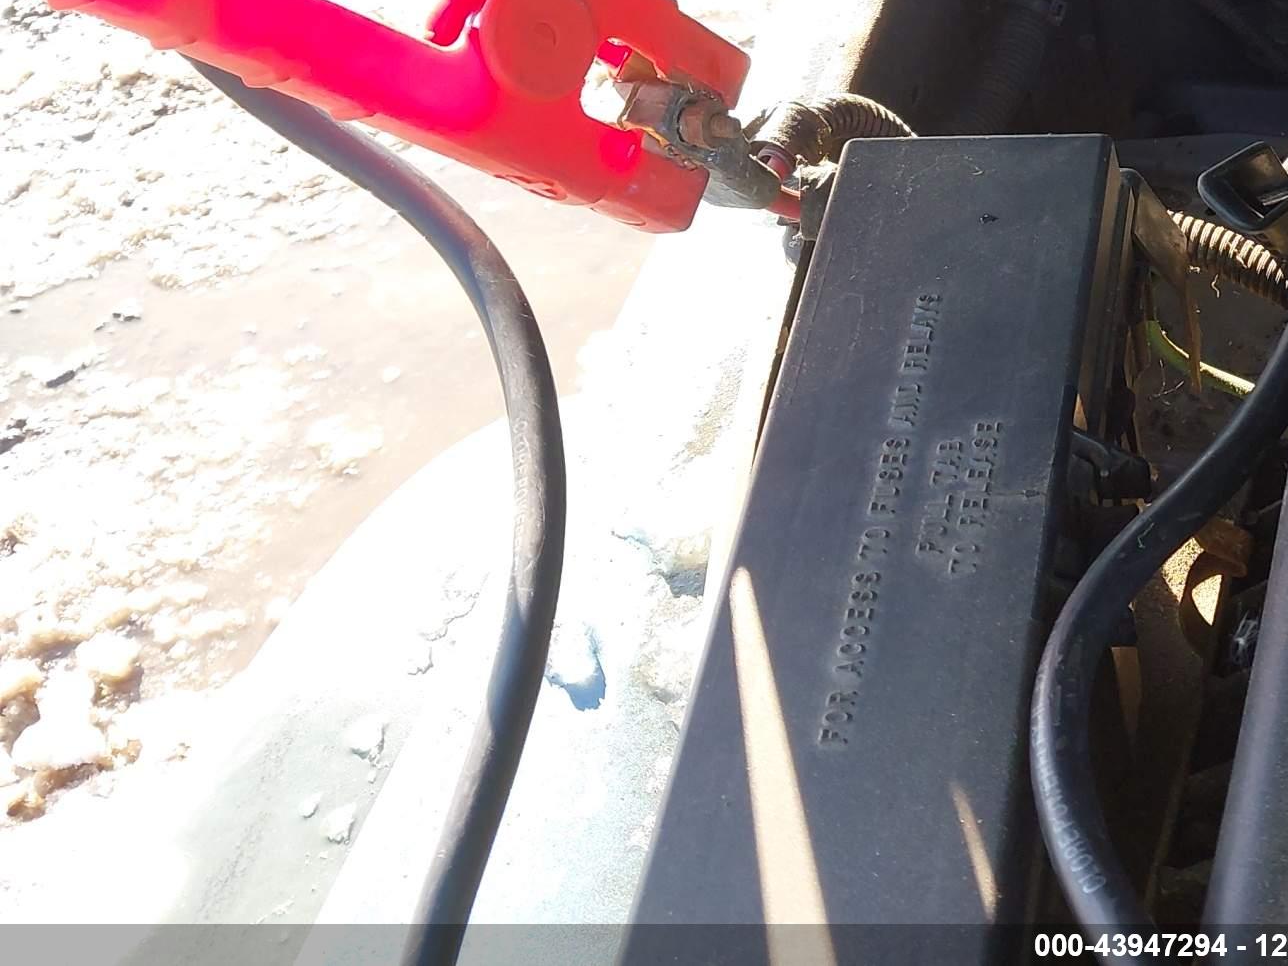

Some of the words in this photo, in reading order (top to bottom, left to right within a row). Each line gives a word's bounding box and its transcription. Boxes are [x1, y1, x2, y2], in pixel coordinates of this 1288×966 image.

[900, 293, 943, 374] RELAYS
[888, 383, 921, 427] AND
[867, 438, 910, 516] FUSES
[930, 440, 964, 487] TAB
[957, 420, 1003, 528] RELEASE
[857, 527, 891, 562] TO
[915, 493, 955, 556] PULL
[948, 543, 980, 576] TO
[833, 571, 882, 678] ACCESS
[818, 689, 860, 746] FOR
